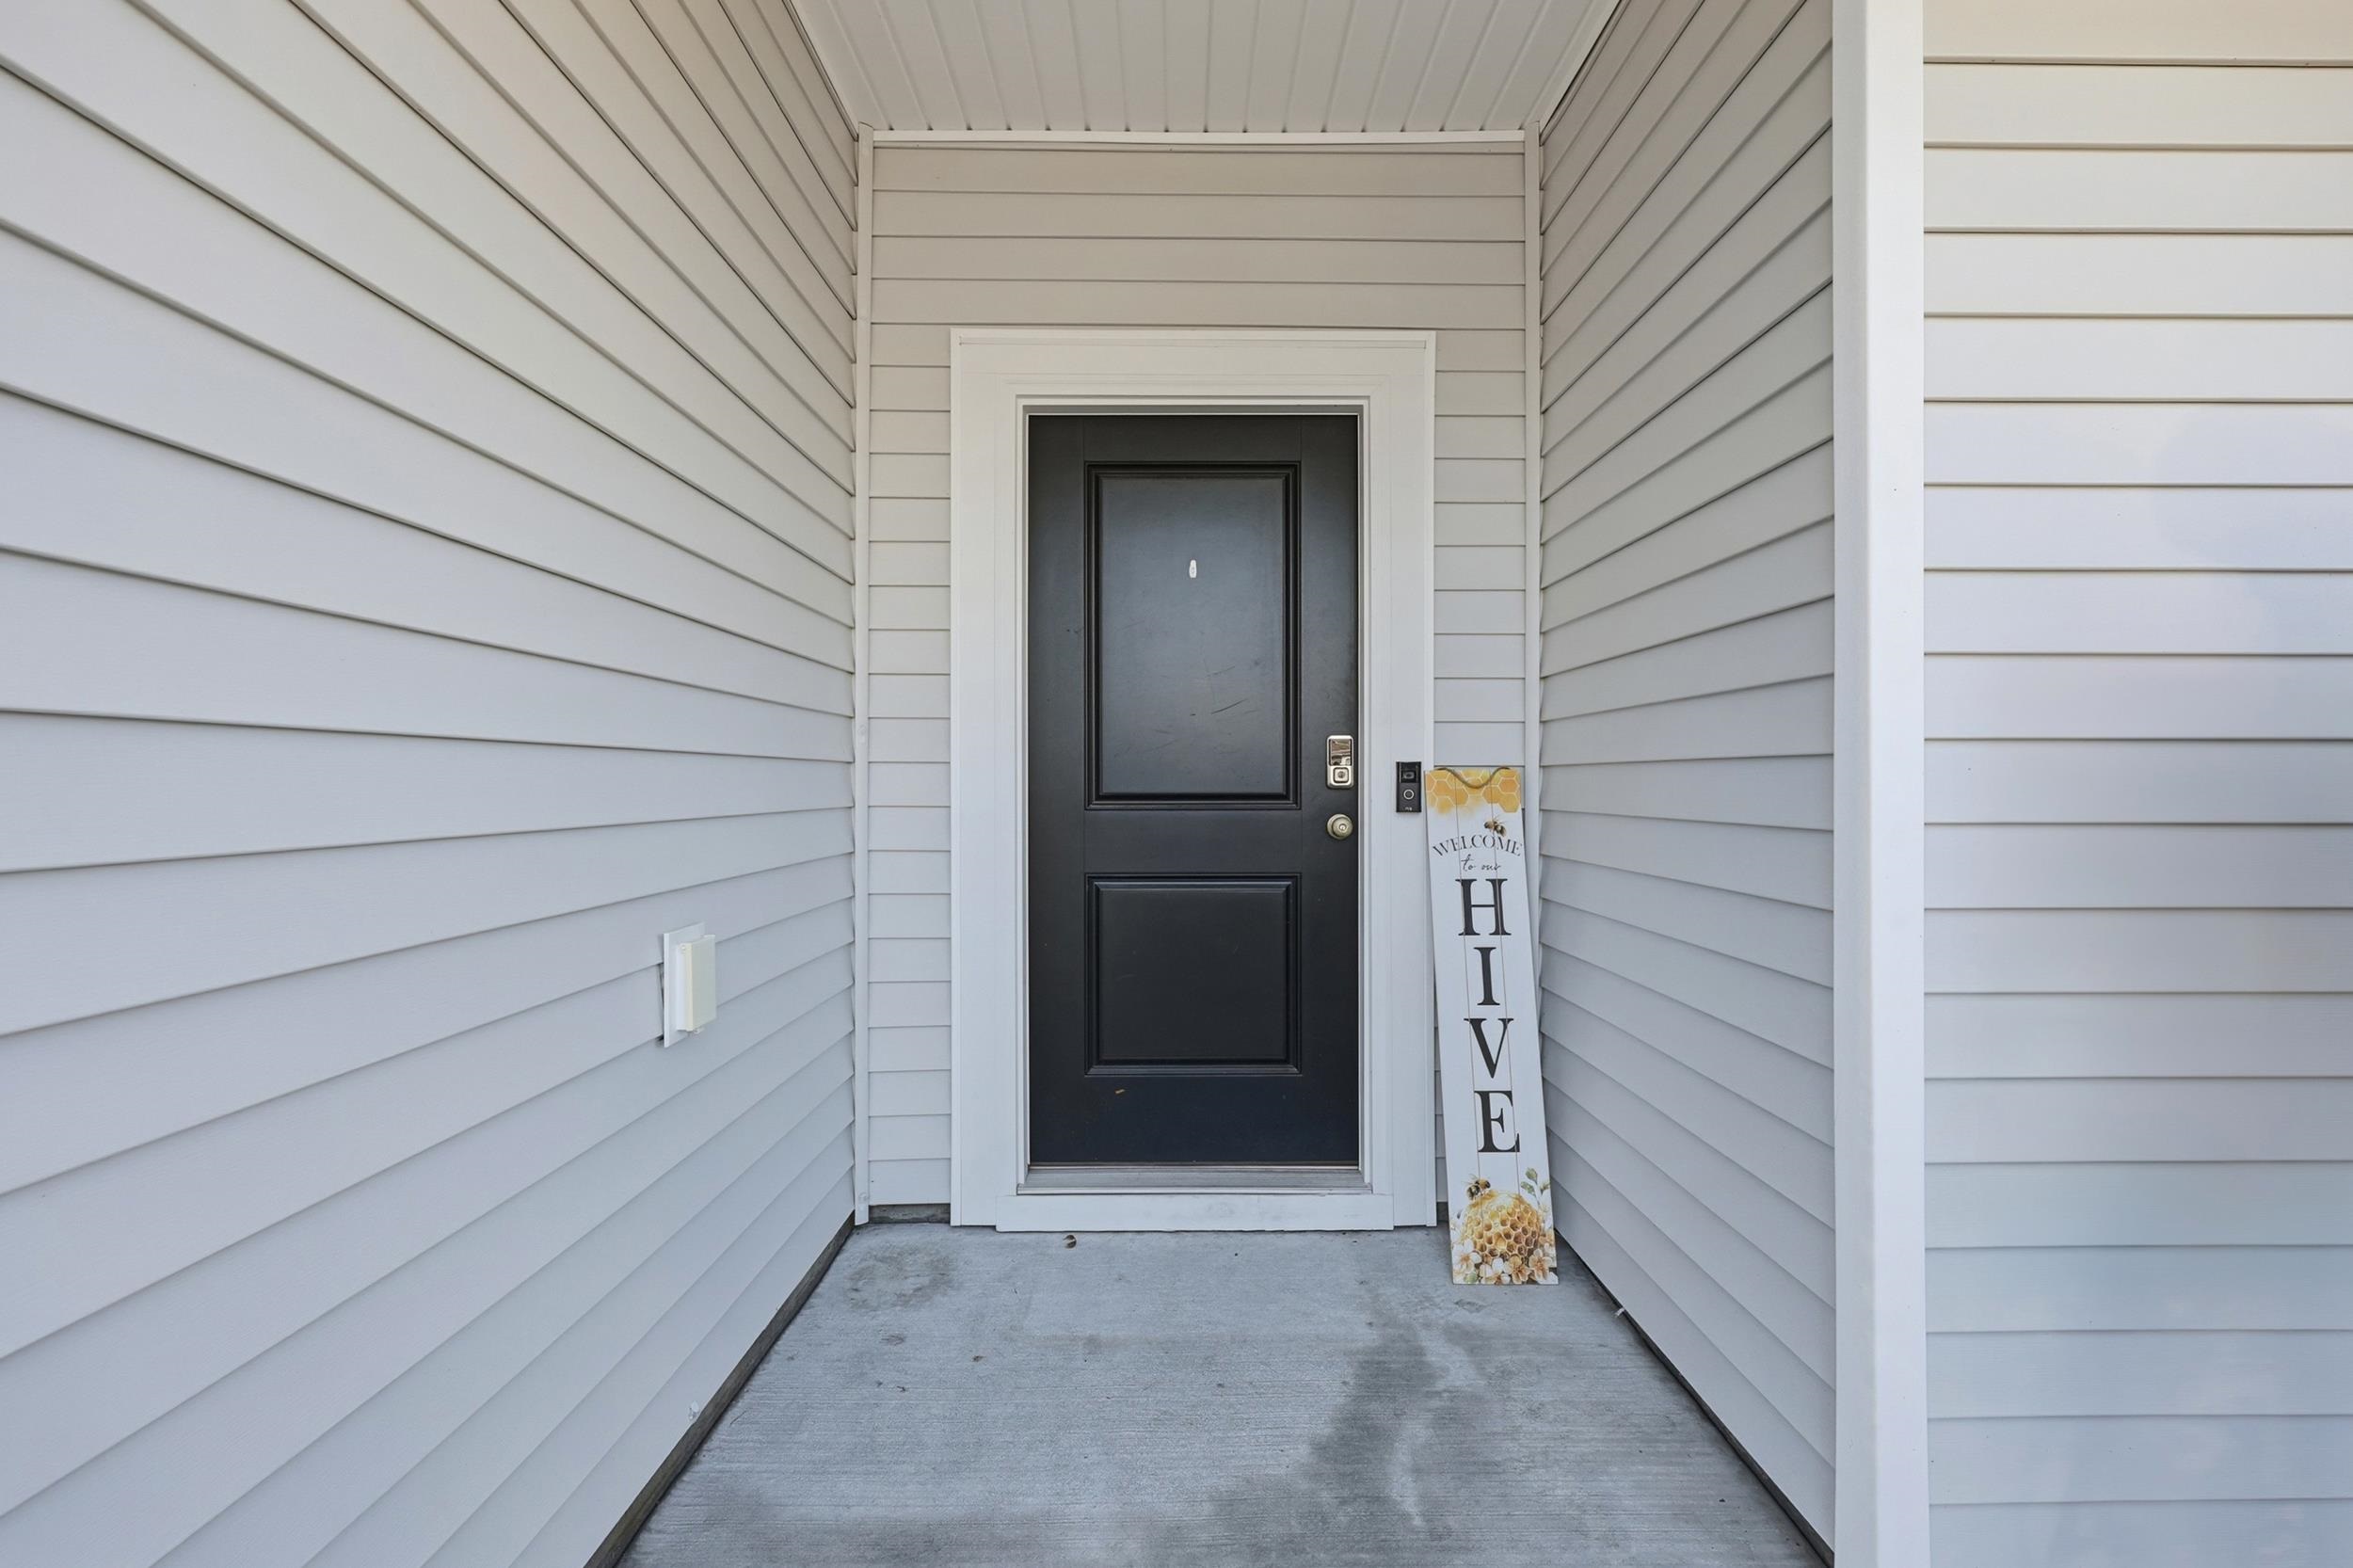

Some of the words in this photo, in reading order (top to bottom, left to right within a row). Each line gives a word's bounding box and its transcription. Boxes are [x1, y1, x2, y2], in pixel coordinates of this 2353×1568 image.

[1433, 834, 1523, 856] WELCOME
[1461, 854, 1475, 872] to
[1455, 878, 1520, 1153] HIVE
